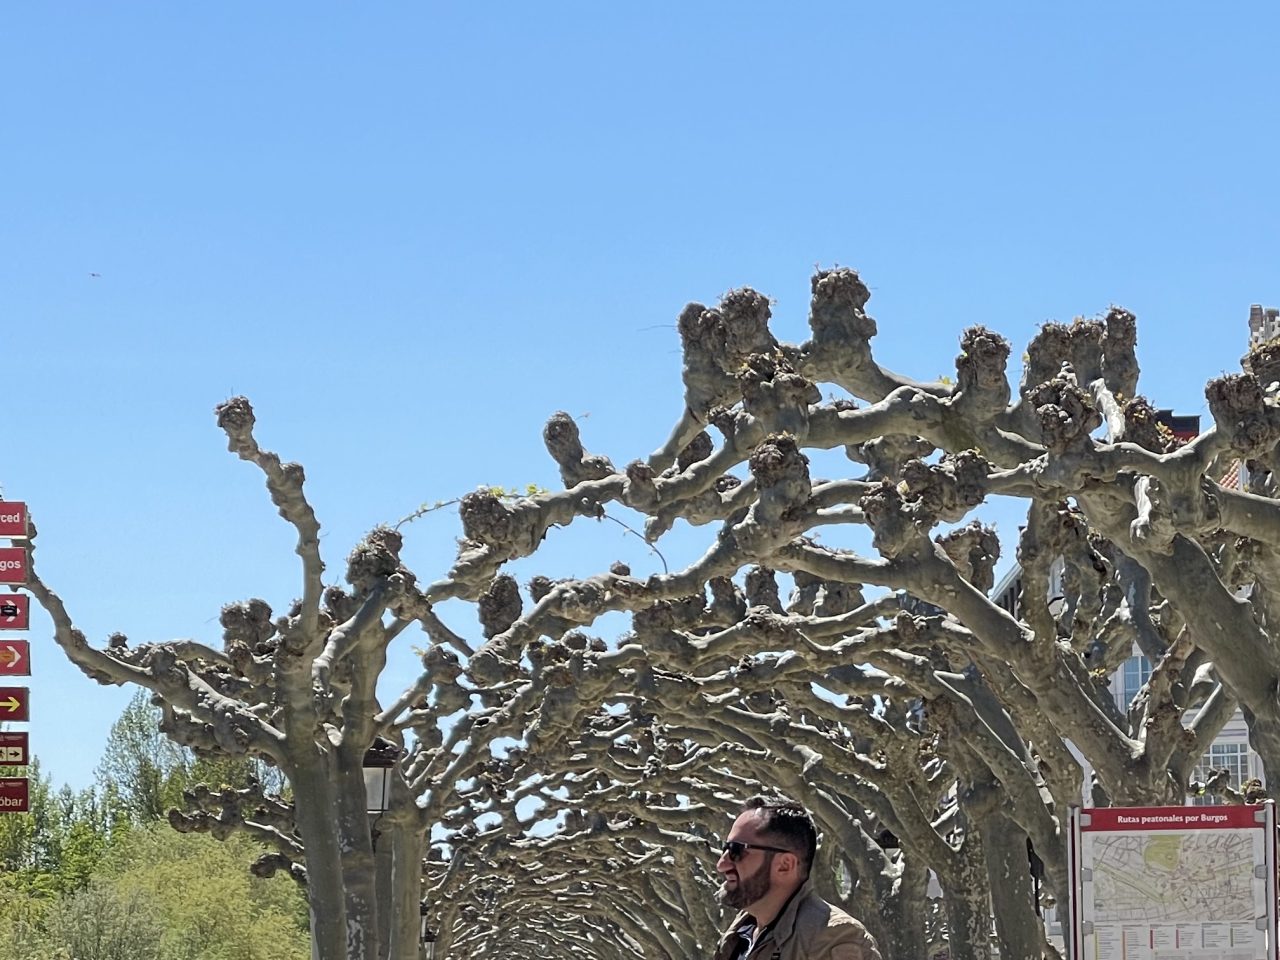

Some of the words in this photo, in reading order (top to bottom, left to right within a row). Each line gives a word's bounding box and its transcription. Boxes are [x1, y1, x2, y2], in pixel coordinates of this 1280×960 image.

[0, 513, 20, 523] ced
[1117, 815, 1140, 823] Rutas
[1141, 814, 1184, 825] peatonales
[1185, 815, 1199, 824] por
[1200, 813, 1228, 823] Burgos
